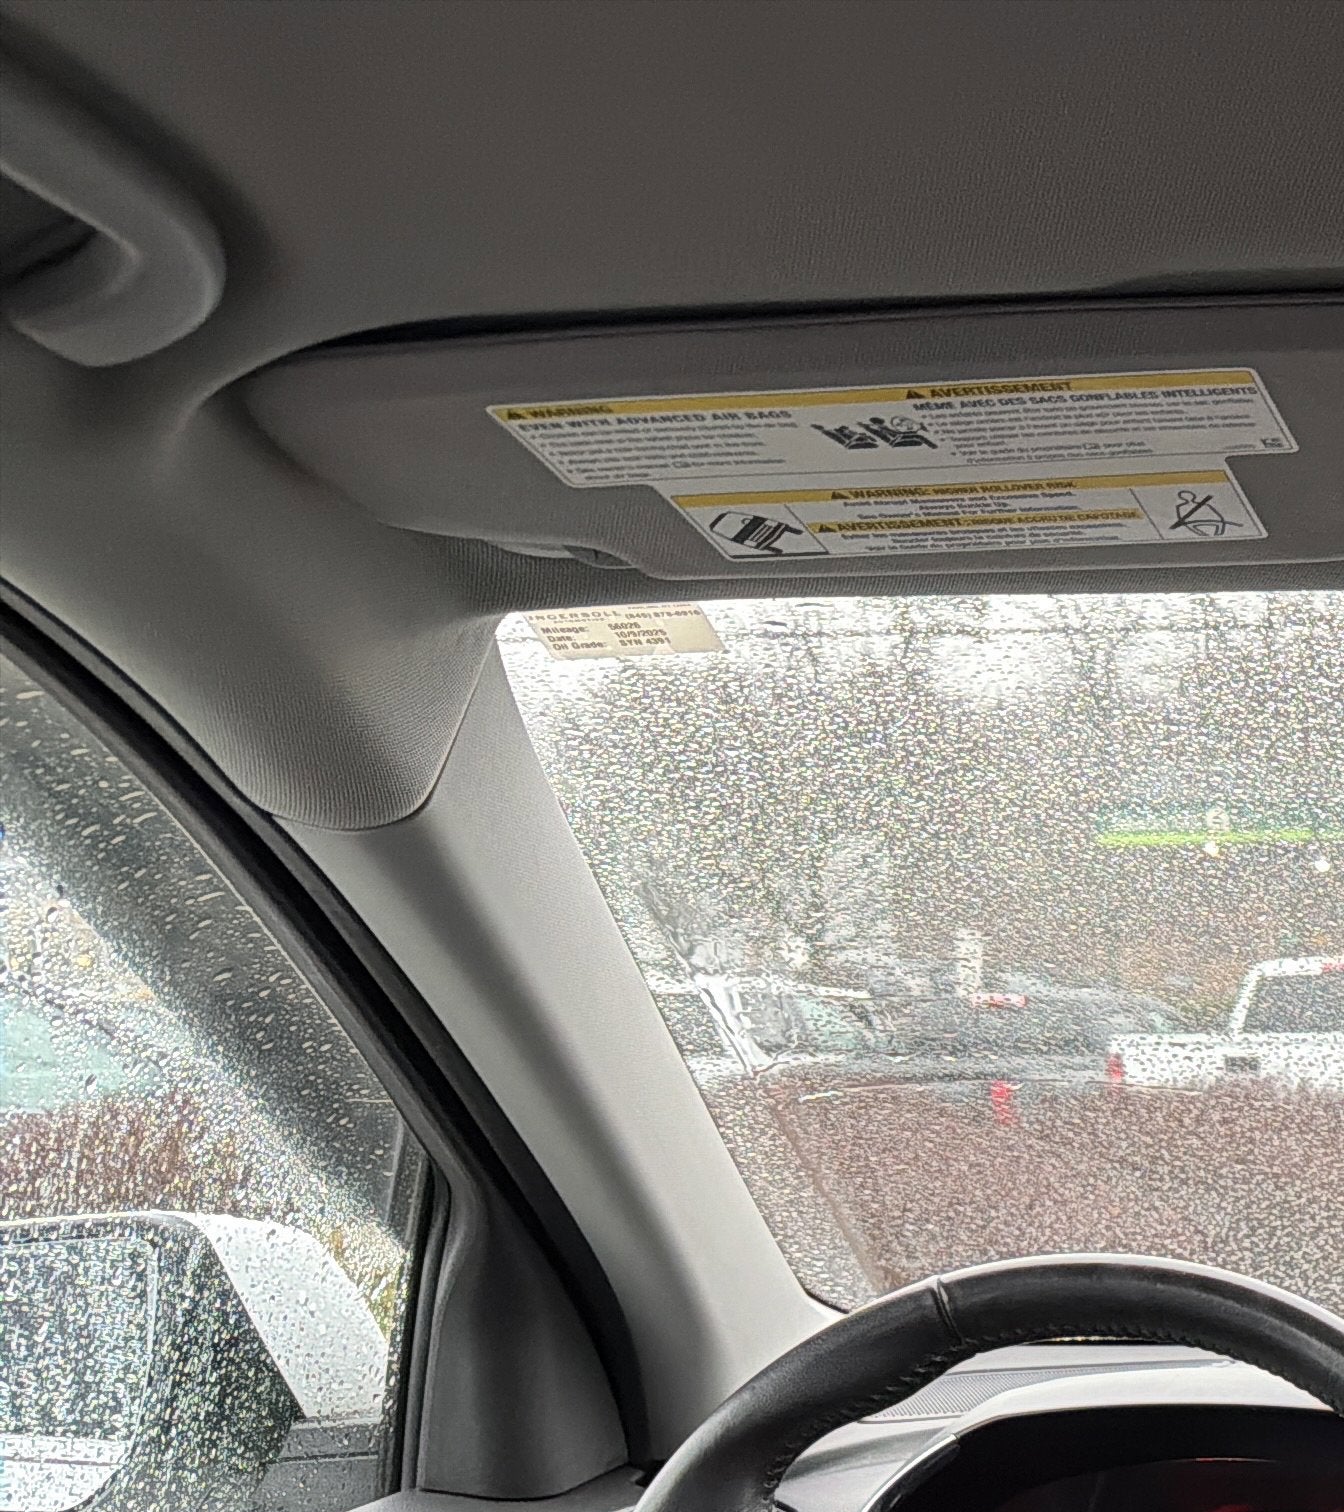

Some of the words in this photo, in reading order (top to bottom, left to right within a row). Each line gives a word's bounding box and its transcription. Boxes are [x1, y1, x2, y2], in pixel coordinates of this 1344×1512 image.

[930, 381, 1072, 398] AVERTISSEMENT
[960, 399, 996, 409] AVEC
[998, 396, 1027, 406] DES
[1029, 394, 1068, 405] SACS
[1161, 386, 1258, 399] INTELLIGENTS
[530, 405, 614, 418] WARNING
[518, 421, 563, 432] EVEN
[566, 418, 612, 428] WITH
[617, 412, 706, 425] ADVANCED
[711, 412, 742, 421] AIR
[744, 410, 793, 420] BAGS
[980, 482, 1045, 493] ROLLOVER
[837, 517, 961, 532] AVERTISSEMENT
[528, 609, 622, 622] INGERSOLL
[540, 625, 589, 635] Mileage:
[547, 635, 577, 643] Date:
